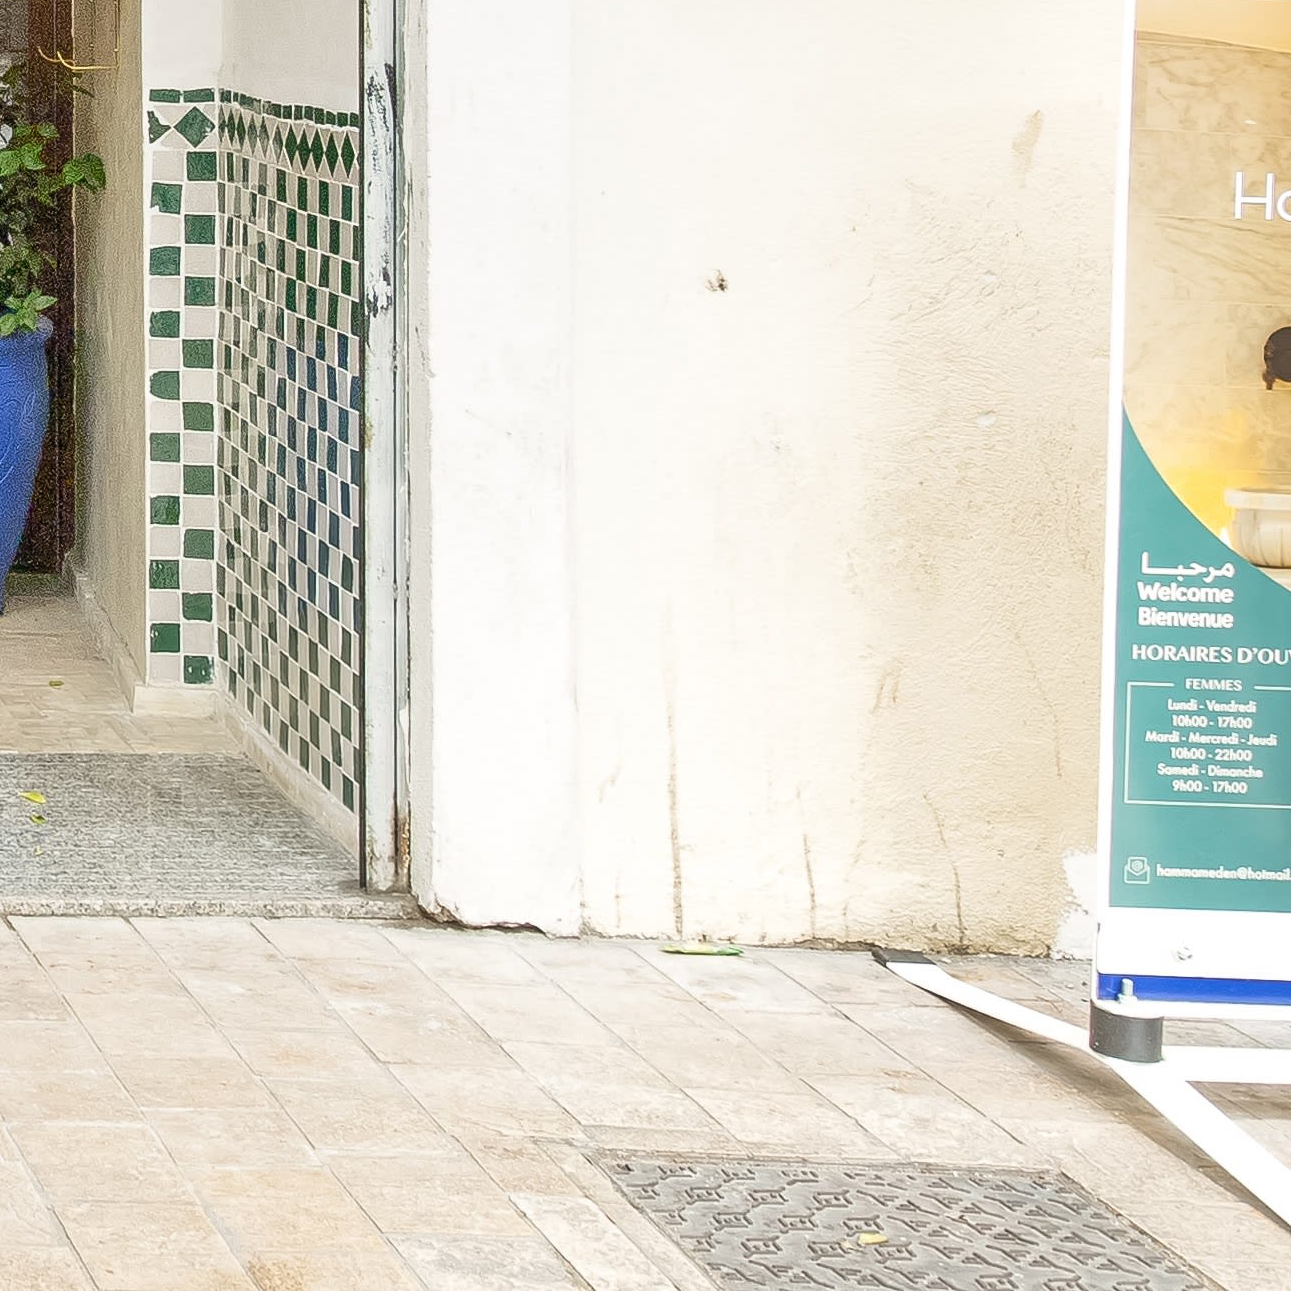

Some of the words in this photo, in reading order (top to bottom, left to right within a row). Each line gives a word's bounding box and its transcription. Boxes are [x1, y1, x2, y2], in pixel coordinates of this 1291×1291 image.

[1141, 551, 1235, 583] مرحبا
[1138, 582, 1234, 603] Welcome
[1138, 607, 1233, 629] Bienvenue
[1132, 645, 1232, 663] HORAIRES
[1237, 648, 1291, 665] D'OU
[1186, 679, 1242, 691] FEMMES
[1168, 700, 1198, 711] Lundi
[1206, 700, 1257, 713] Vendredi
[1172, 715, 1207, 727] 10h00
[1218, 716, 1253, 728] 17h00
[1145, 731, 1180, 743] Mardi
[1189, 733, 1239, 745] Mercredi
[1247, 734, 1277, 746] Jeudi
[1171, 747, 1205, 759] 10h00
[1215, 749, 1253, 761] 22h00
[1157, 763, 1199, 776] Samedi
[1208, 766, 1263, 778] Dimanche
[1172, 781, 1202, 792] 9h00
[1213, 781, 1248, 794] 17h00
